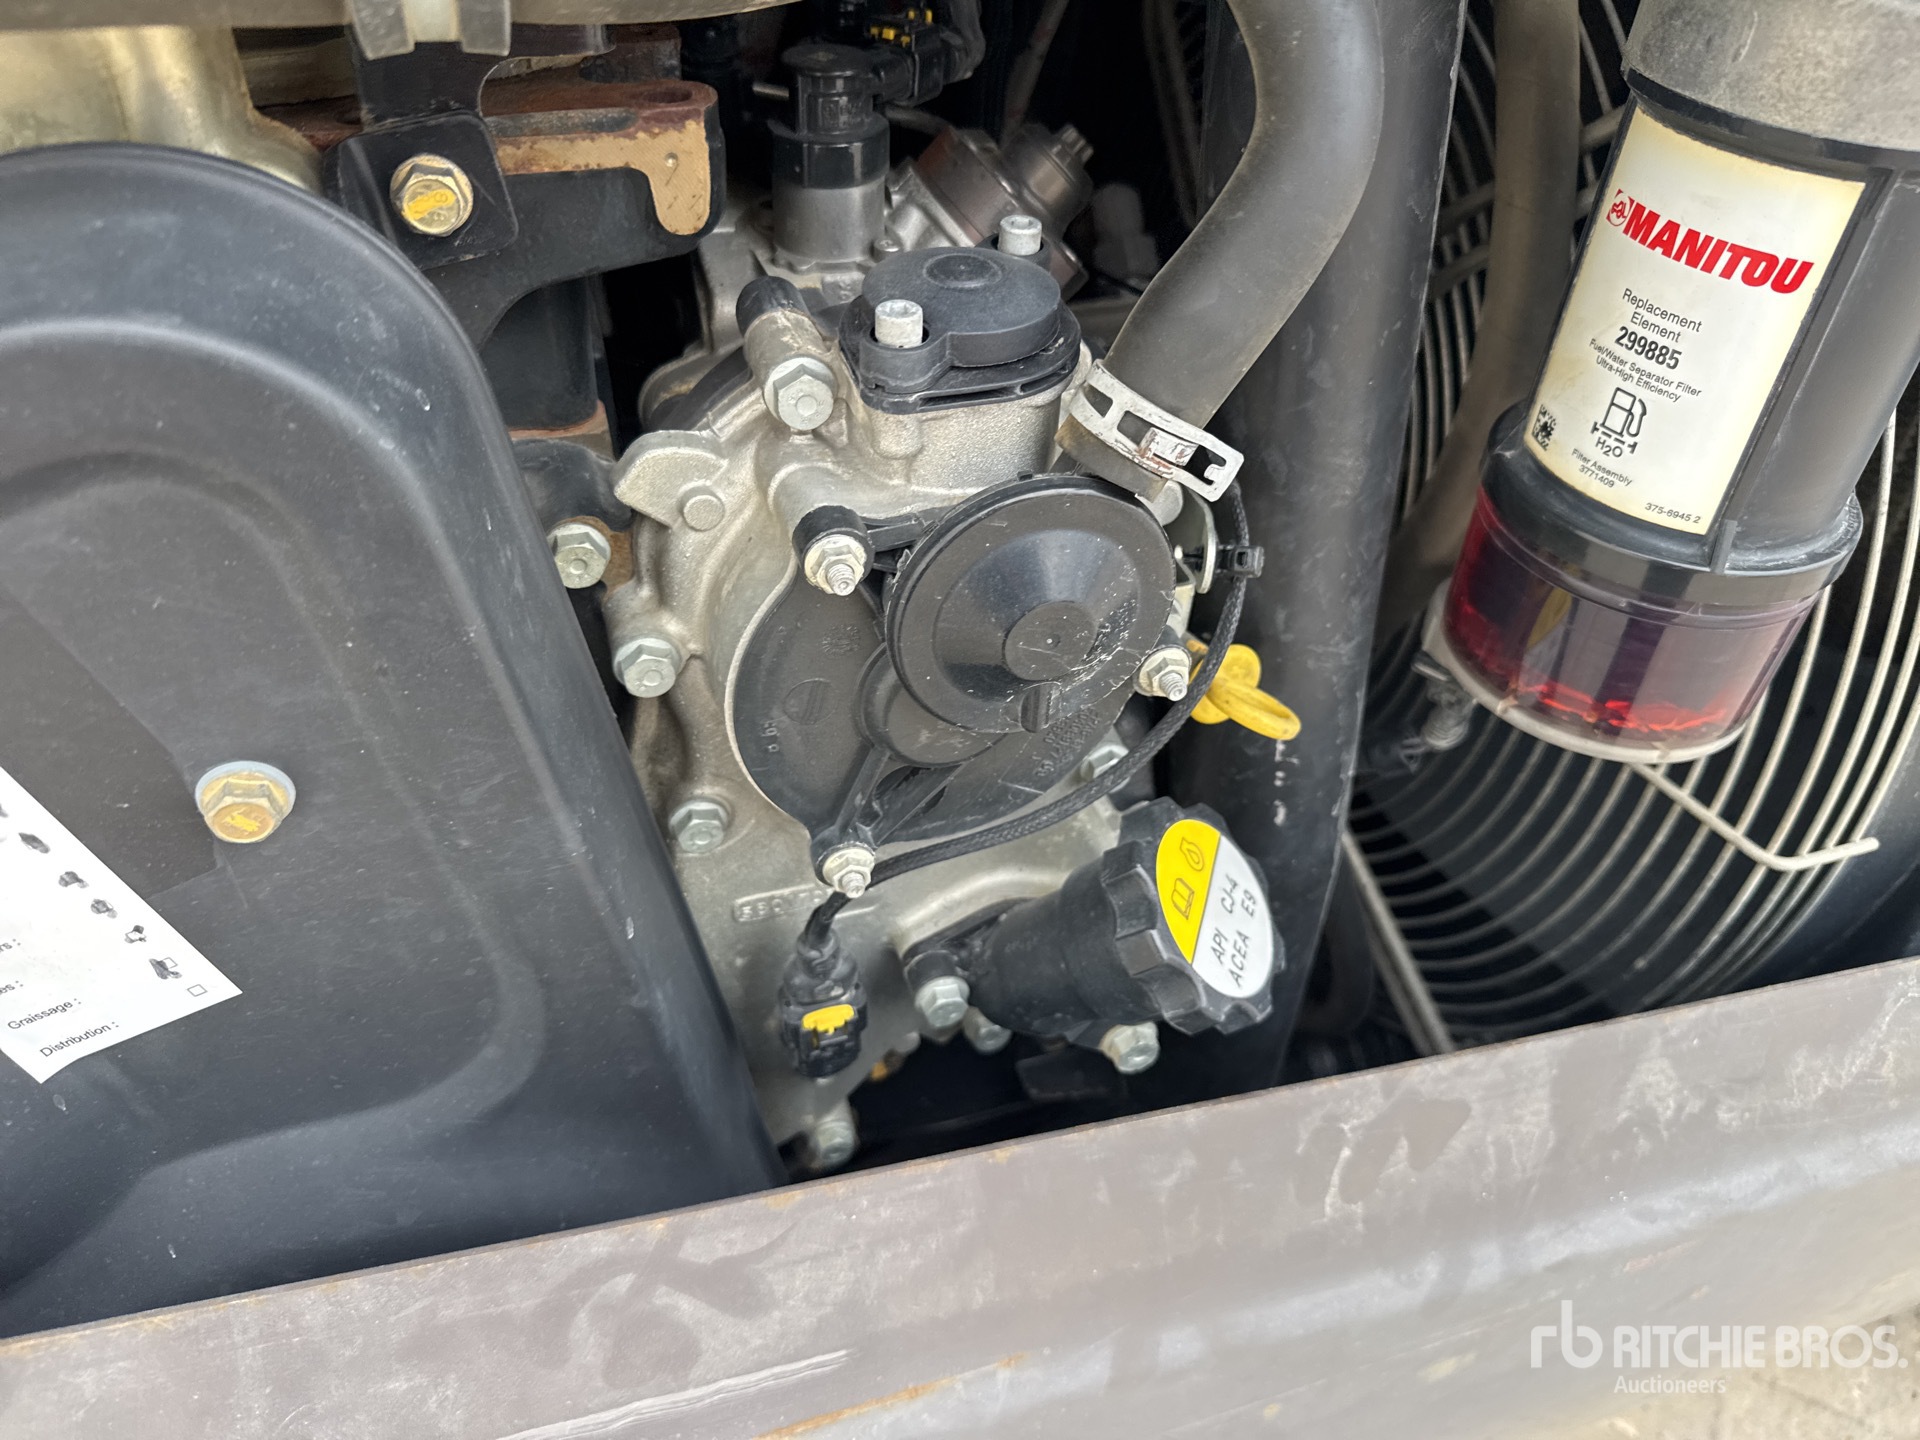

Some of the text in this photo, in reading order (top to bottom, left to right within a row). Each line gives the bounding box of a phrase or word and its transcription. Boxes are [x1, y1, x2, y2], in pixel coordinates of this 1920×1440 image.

[1622, 202, 1815, 294] MANITOU
[1622, 288, 1702, 332] Replacement
[1630, 311, 1681, 343] Element
[1589, 338, 1702, 397] Fuel/Water Separator Filter
[1614, 326, 1682, 370] 299885
[1596, 354, 1681, 403] Ultra-High Efficiency
[1571, 448, 1632, 487] Filter Assembly
[1578, 464, 1615, 488] 3771409
[1644, 502, 1701, 524] 375-6945 2
[1211, 874, 1239, 965] API CJ-4
[1229, 889, 1257, 988] ACEA E9
[7, 1001, 73, 1030] Graissage
[39, 1024, 112, 1057] Distribution
